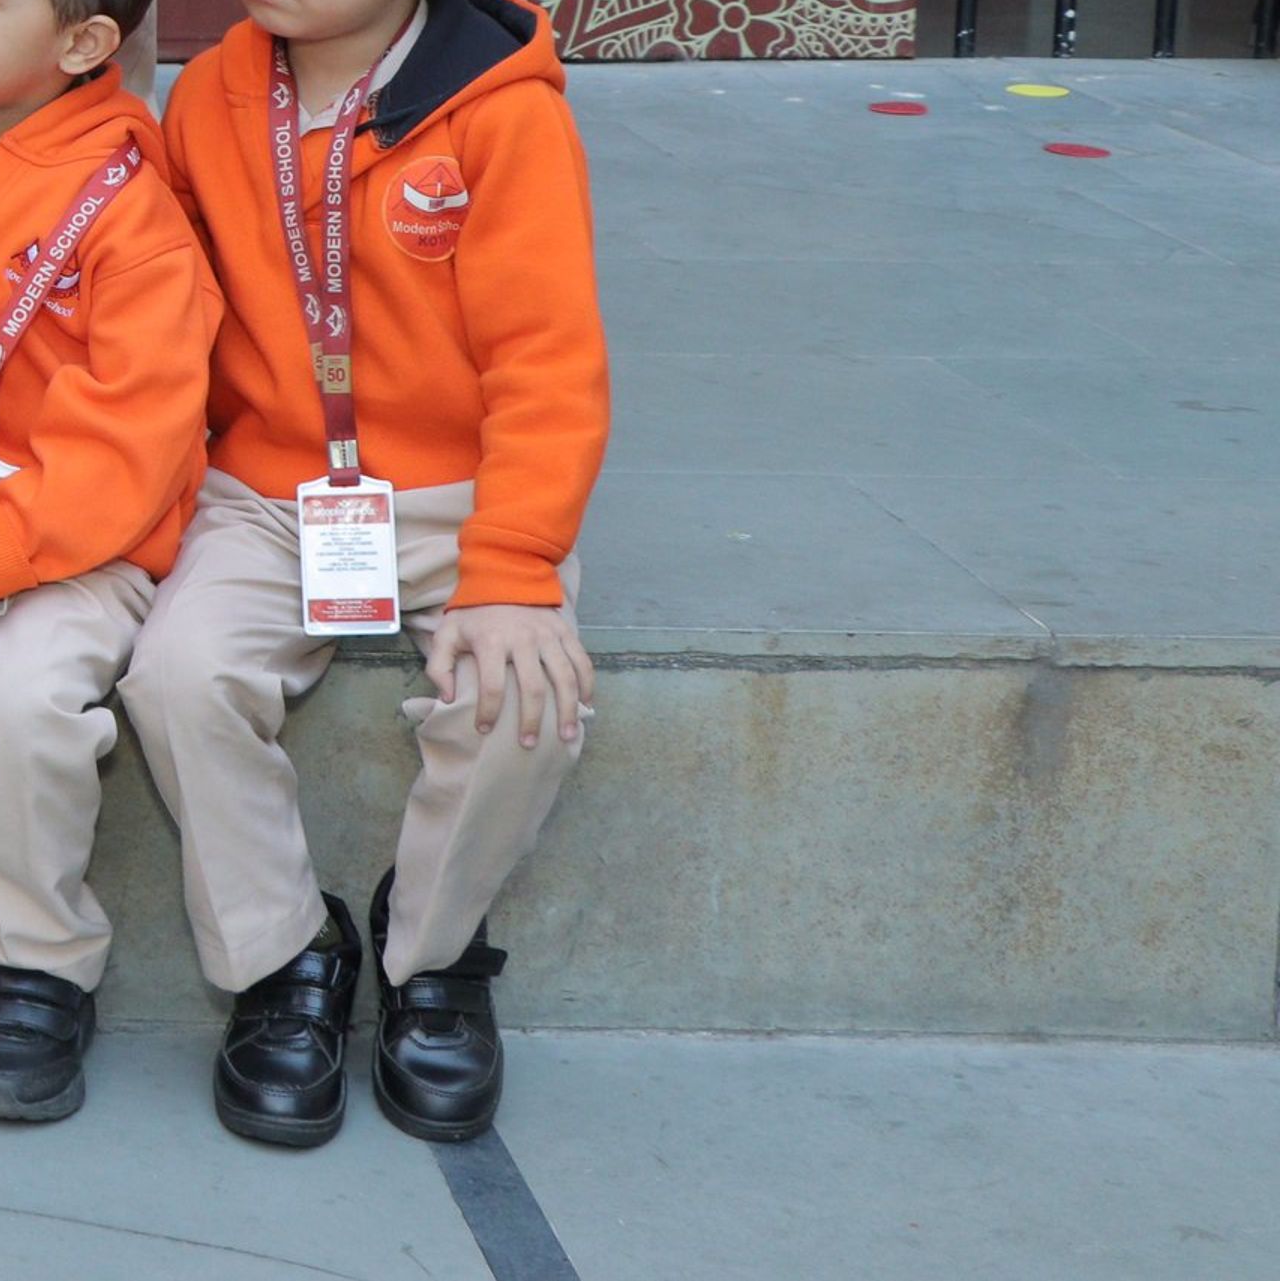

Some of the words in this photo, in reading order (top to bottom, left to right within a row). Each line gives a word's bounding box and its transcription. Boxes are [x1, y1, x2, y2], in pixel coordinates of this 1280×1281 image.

[275, 119, 295, 197] SCHOOL
[327, 126, 349, 205] SCHOOL
[2, 260, 58, 339] MODERN
[49, 192, 105, 261] SCHOOL
[282, 200, 312, 283] MODERN
[325, 209, 343, 294] MODERN
[392, 220, 437, 235] Modern
[326, 367, 346, 382] 50
